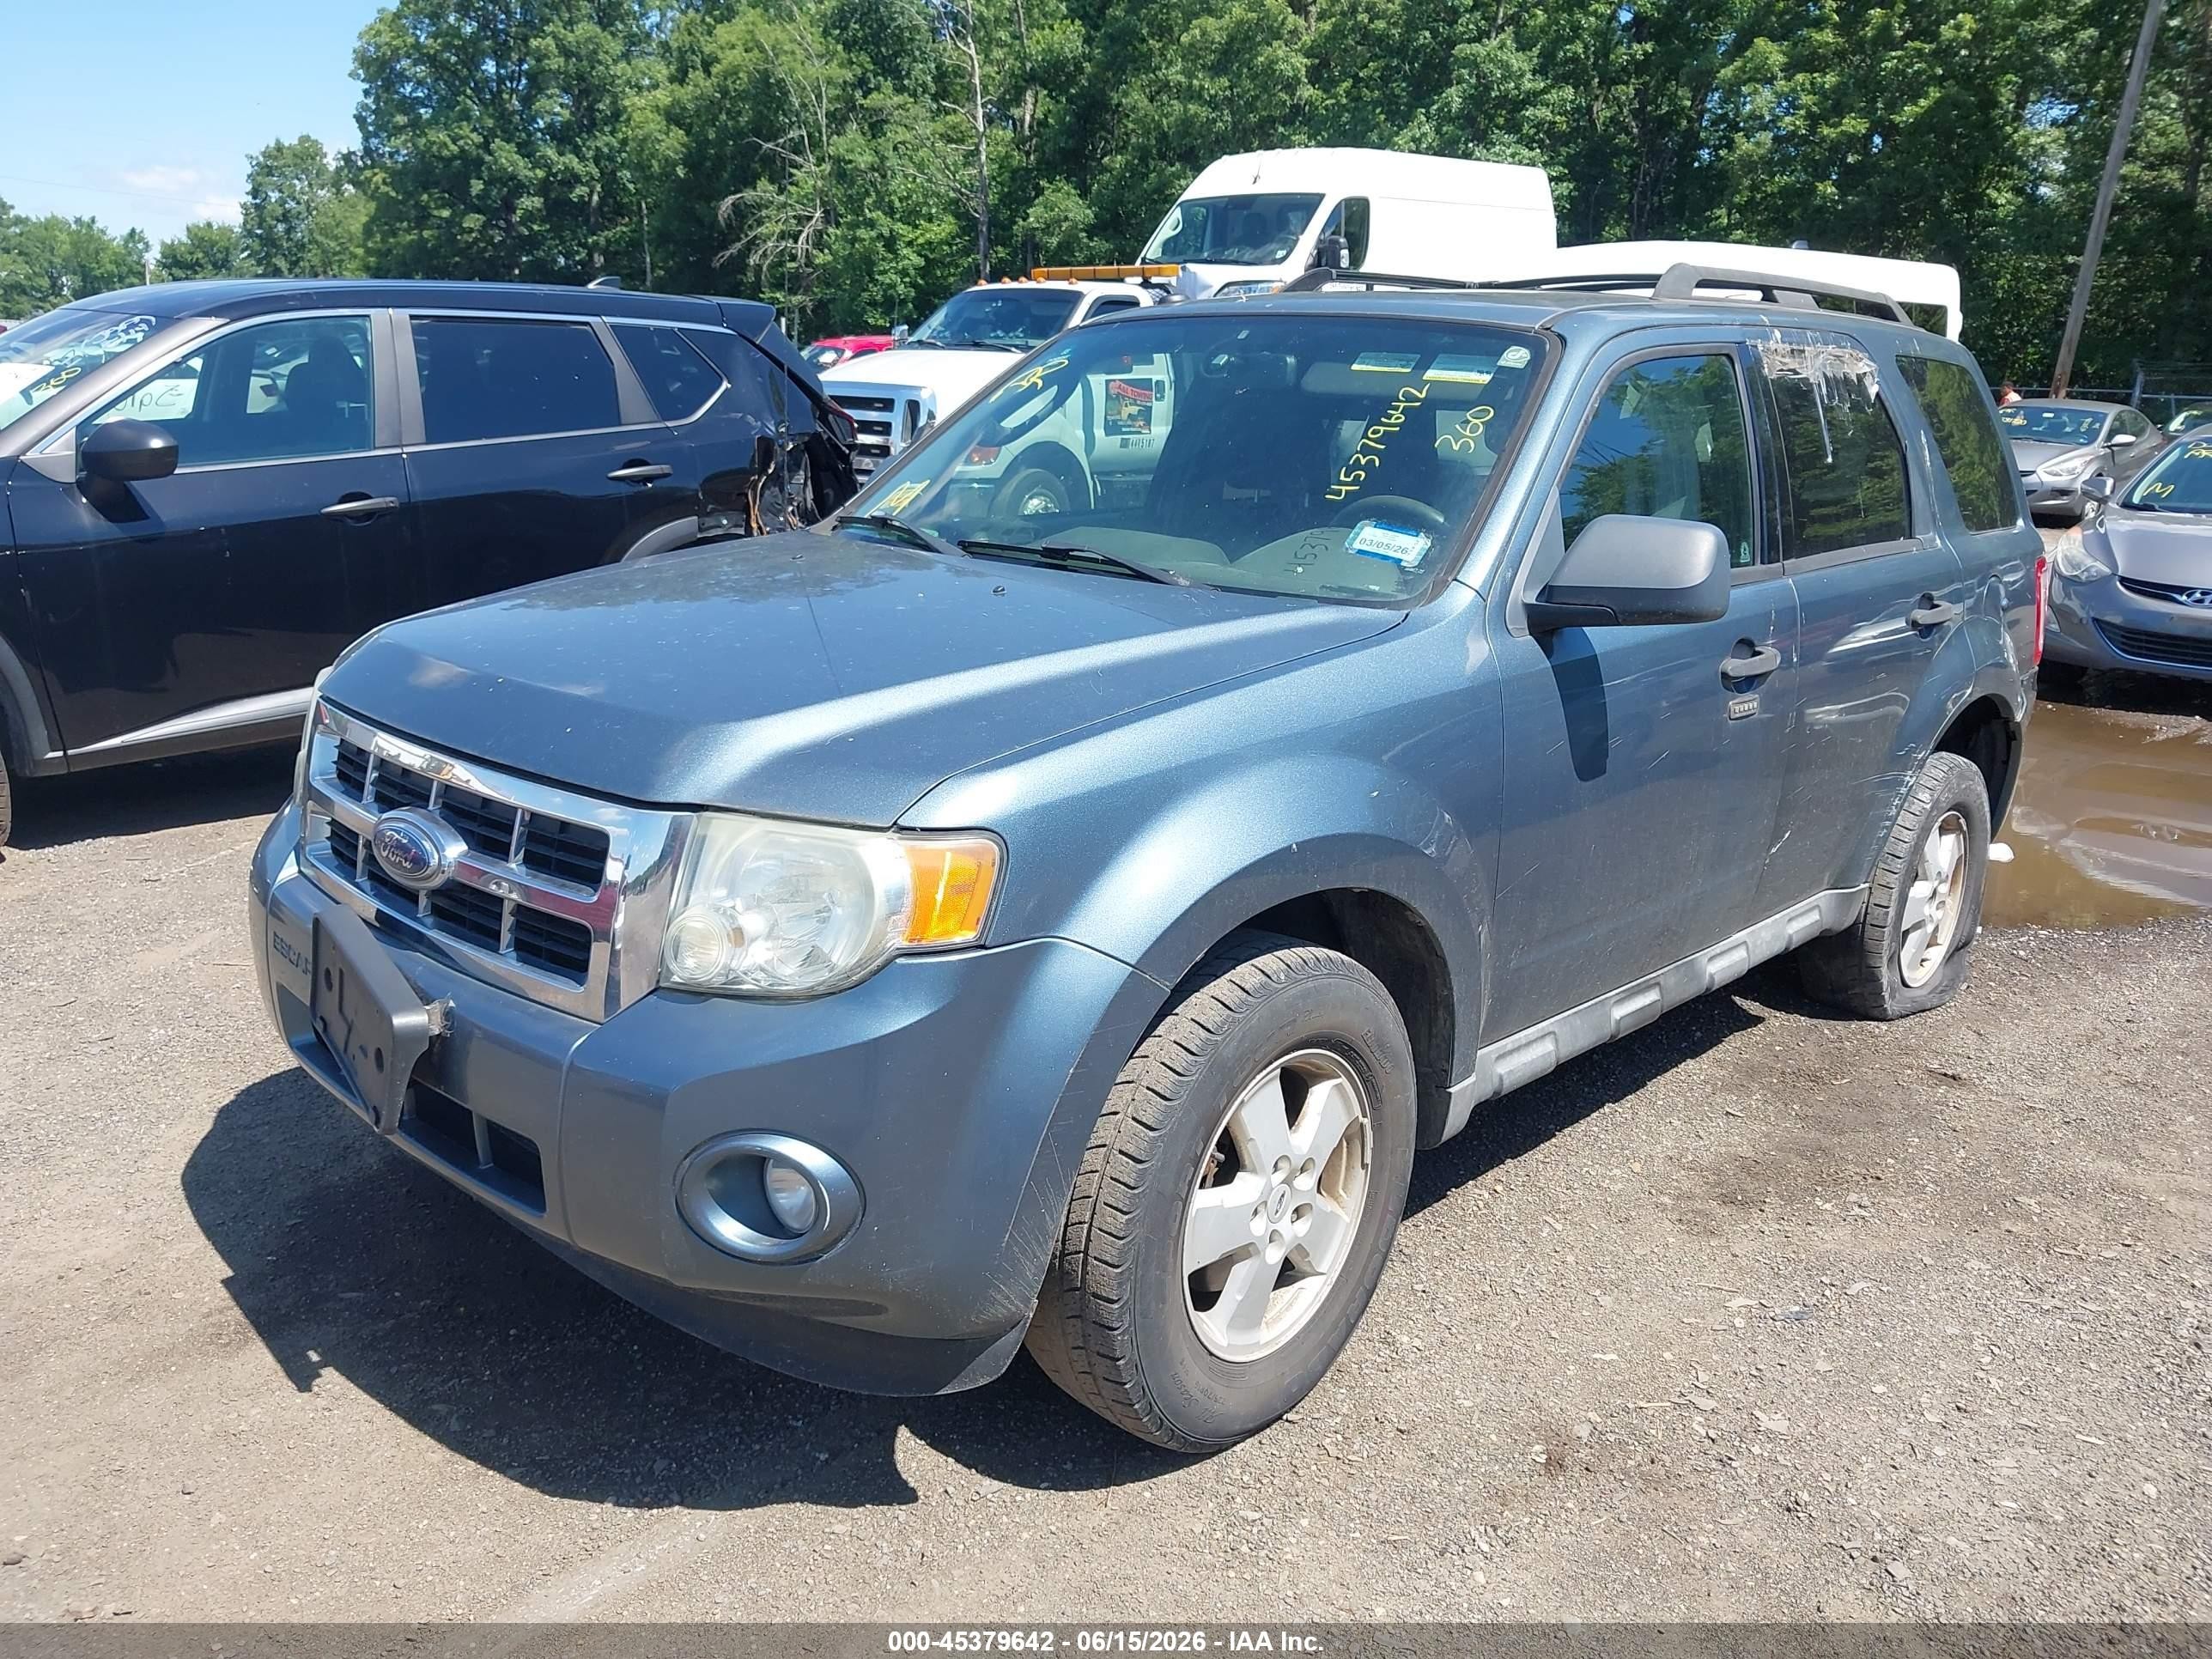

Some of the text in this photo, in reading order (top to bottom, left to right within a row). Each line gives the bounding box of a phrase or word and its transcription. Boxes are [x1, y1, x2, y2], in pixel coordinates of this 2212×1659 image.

[1324, 382, 1431, 501] 45379642
[1434, 405, 1494, 453] 360
[1358, 537, 1409, 556] 03/05/26
